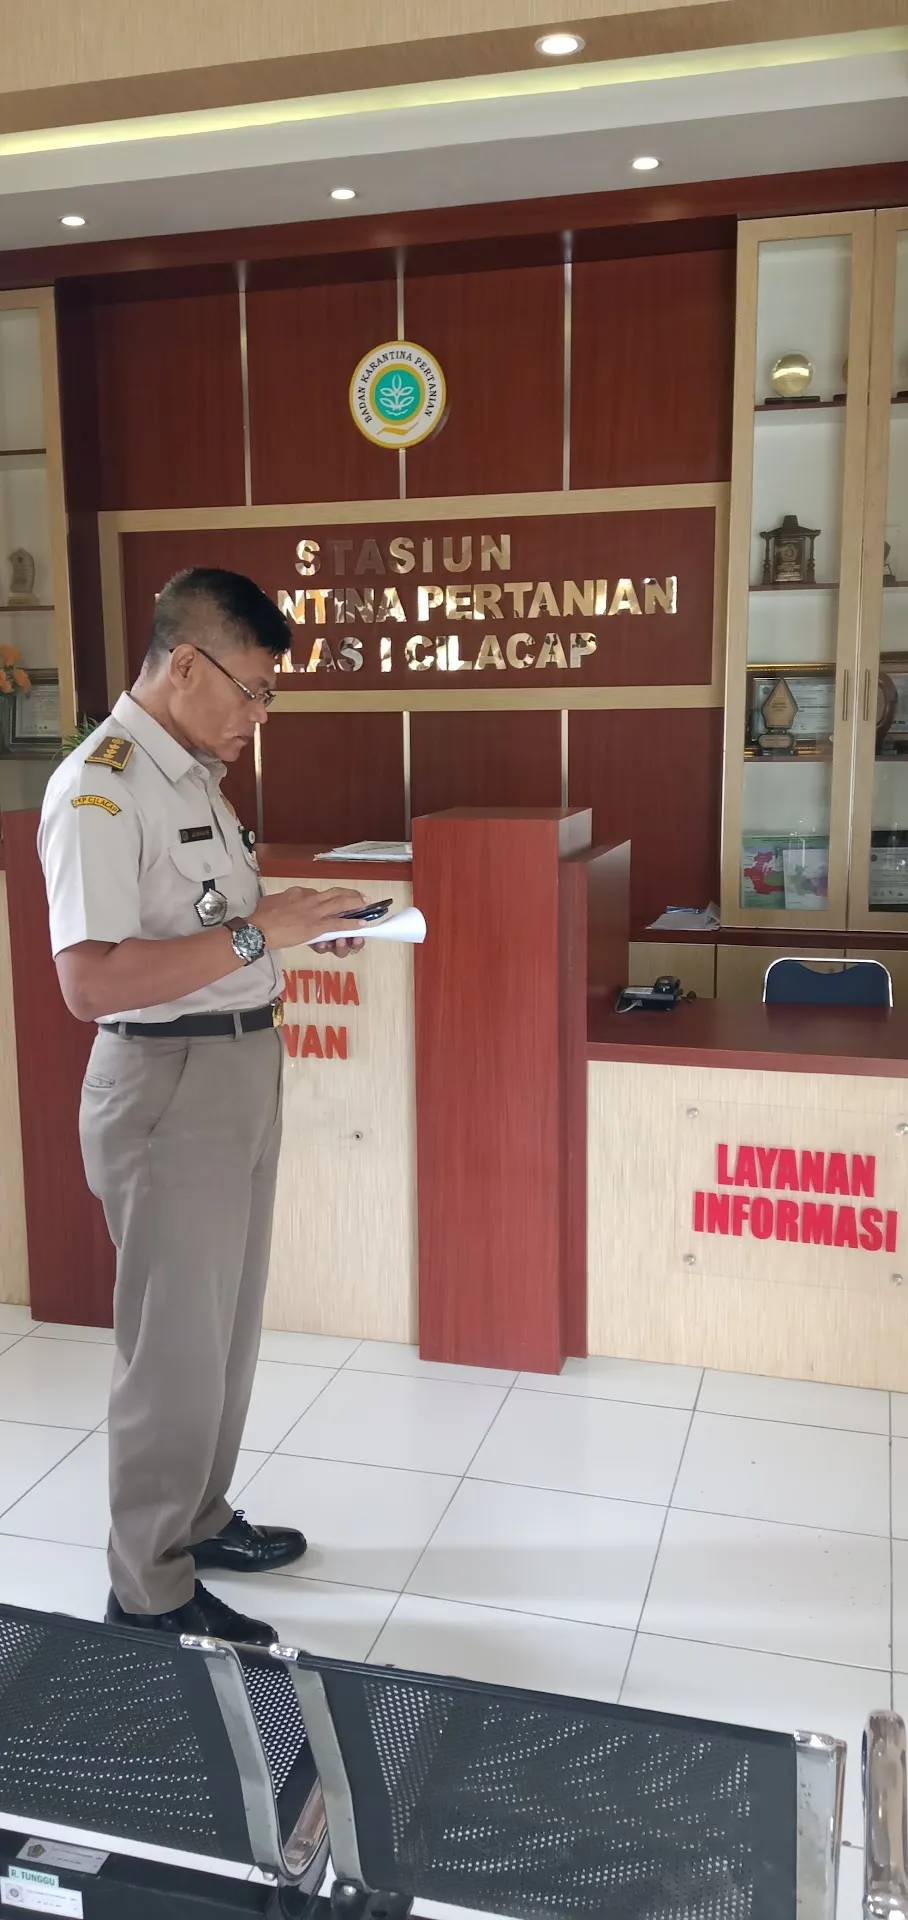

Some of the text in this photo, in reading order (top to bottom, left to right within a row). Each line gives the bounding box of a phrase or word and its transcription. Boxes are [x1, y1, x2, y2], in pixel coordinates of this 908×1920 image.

[357, 350, 437, 423] BADAN KARANTINA PERTANIAN
[294, 534, 511, 576] STASIUN
[417, 576, 678, 622] PERTANIAN
[273, 631, 598, 673] LAS I CILACAP
[281, 969, 360, 1006] NTINA
[716, 1143, 877, 1197] LAYANAN
[693, 1191, 898, 1253] INFORMASI
[10, 1869, 56, 1886] R. TUNGGU
